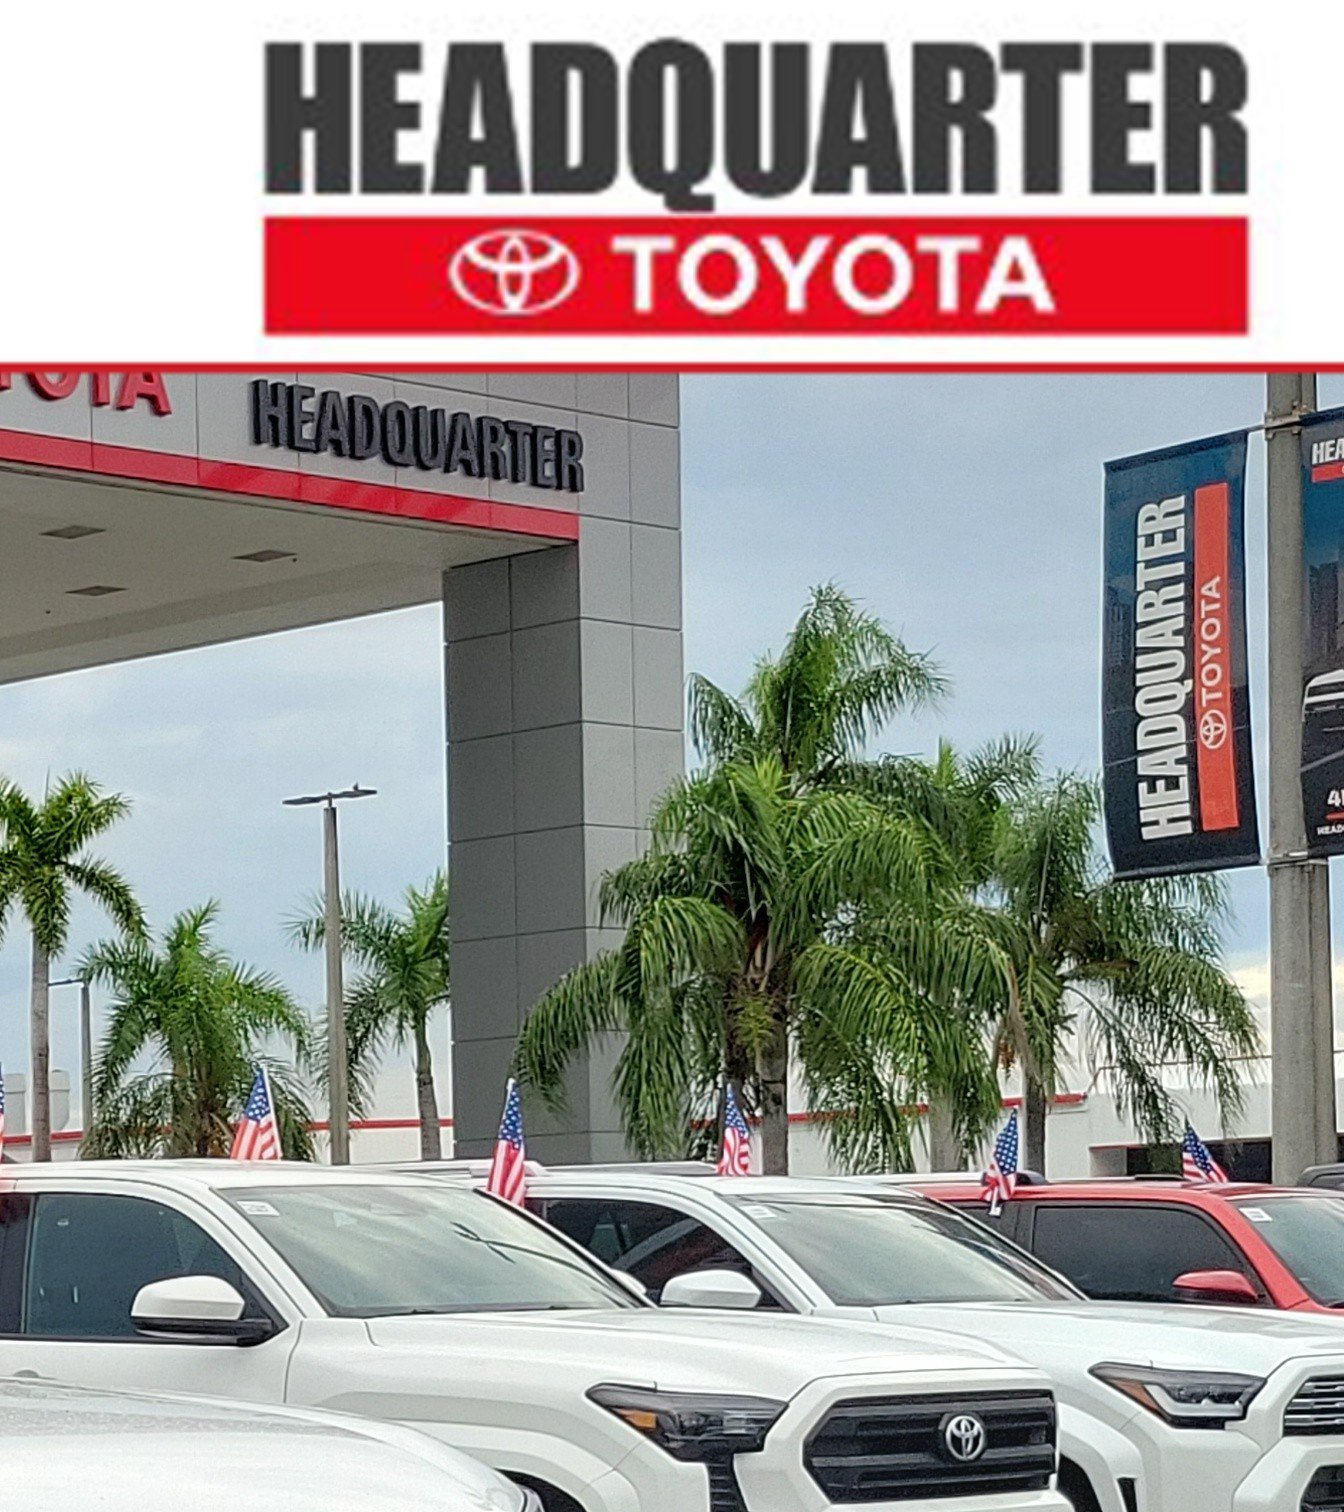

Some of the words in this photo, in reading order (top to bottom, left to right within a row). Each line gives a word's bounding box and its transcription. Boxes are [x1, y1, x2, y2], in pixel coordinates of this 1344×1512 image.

[250, 379, 585, 493] HEADQUARTER
[1135, 494, 1193, 841] HEADQUARTER
[1199, 576, 1222, 707] TOYOTA
